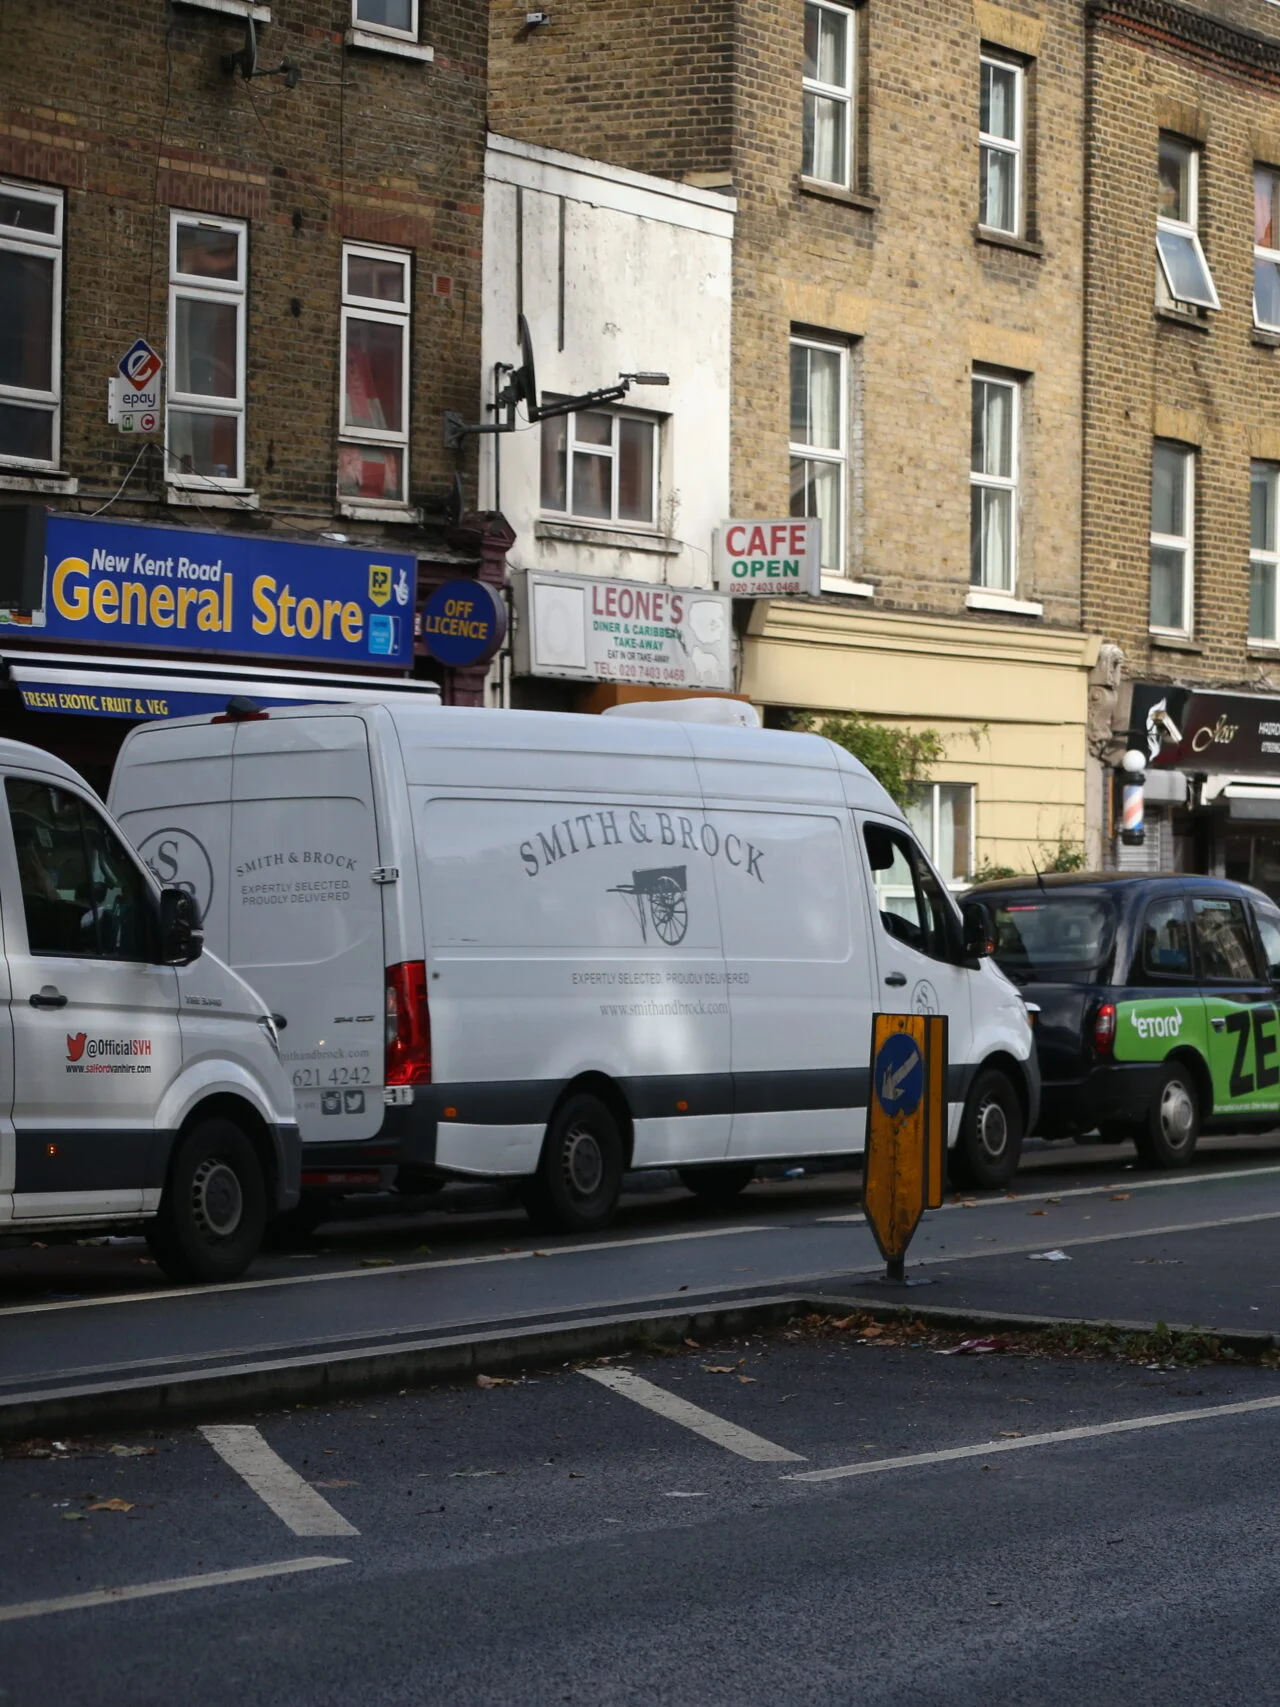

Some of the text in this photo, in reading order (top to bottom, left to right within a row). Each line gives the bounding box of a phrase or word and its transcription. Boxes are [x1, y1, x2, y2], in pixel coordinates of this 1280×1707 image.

[122, 393, 156, 408] epay
[725, 525, 807, 557] CAFE
[91, 548, 222, 582] New Kent Road
[731, 560, 800, 578] OPEN
[729, 581, 800, 593] 020 7403 0468
[52, 557, 364, 643] General Store
[444, 599, 474, 618] OFF
[592, 585, 683, 625] LEONE'S
[425, 615, 489, 640] LICENCE
[593, 620, 620, 633] DINER
[623, 623, 630, 634] &
[613, 635, 664, 651] TAKE-AWAY
[607, 649, 618, 659] EAT
[619, 663, 636, 677] 020
[638, 665, 661, 680] 7403
[22, 691, 169, 716] FRESH EXOTIC FRUIT & VEG
[519, 810, 765, 884] SMITH & BROCK
[236, 851, 358, 878] SMITH & BROCK
[241, 882, 291, 895] EXPERTLY
[242, 894, 290, 906] PROUDLY
[572, 972, 616, 985] EXPERTLY
[666, 972, 703, 985] PROUDLY
[599, 999, 729, 1017] www.smithandbrock.com
[86, 1039, 152, 1058] @OfficialSVH
[65, 1063, 152, 1074] www.salfordvanhire.com
[328, 1066, 371, 1086] 4242
